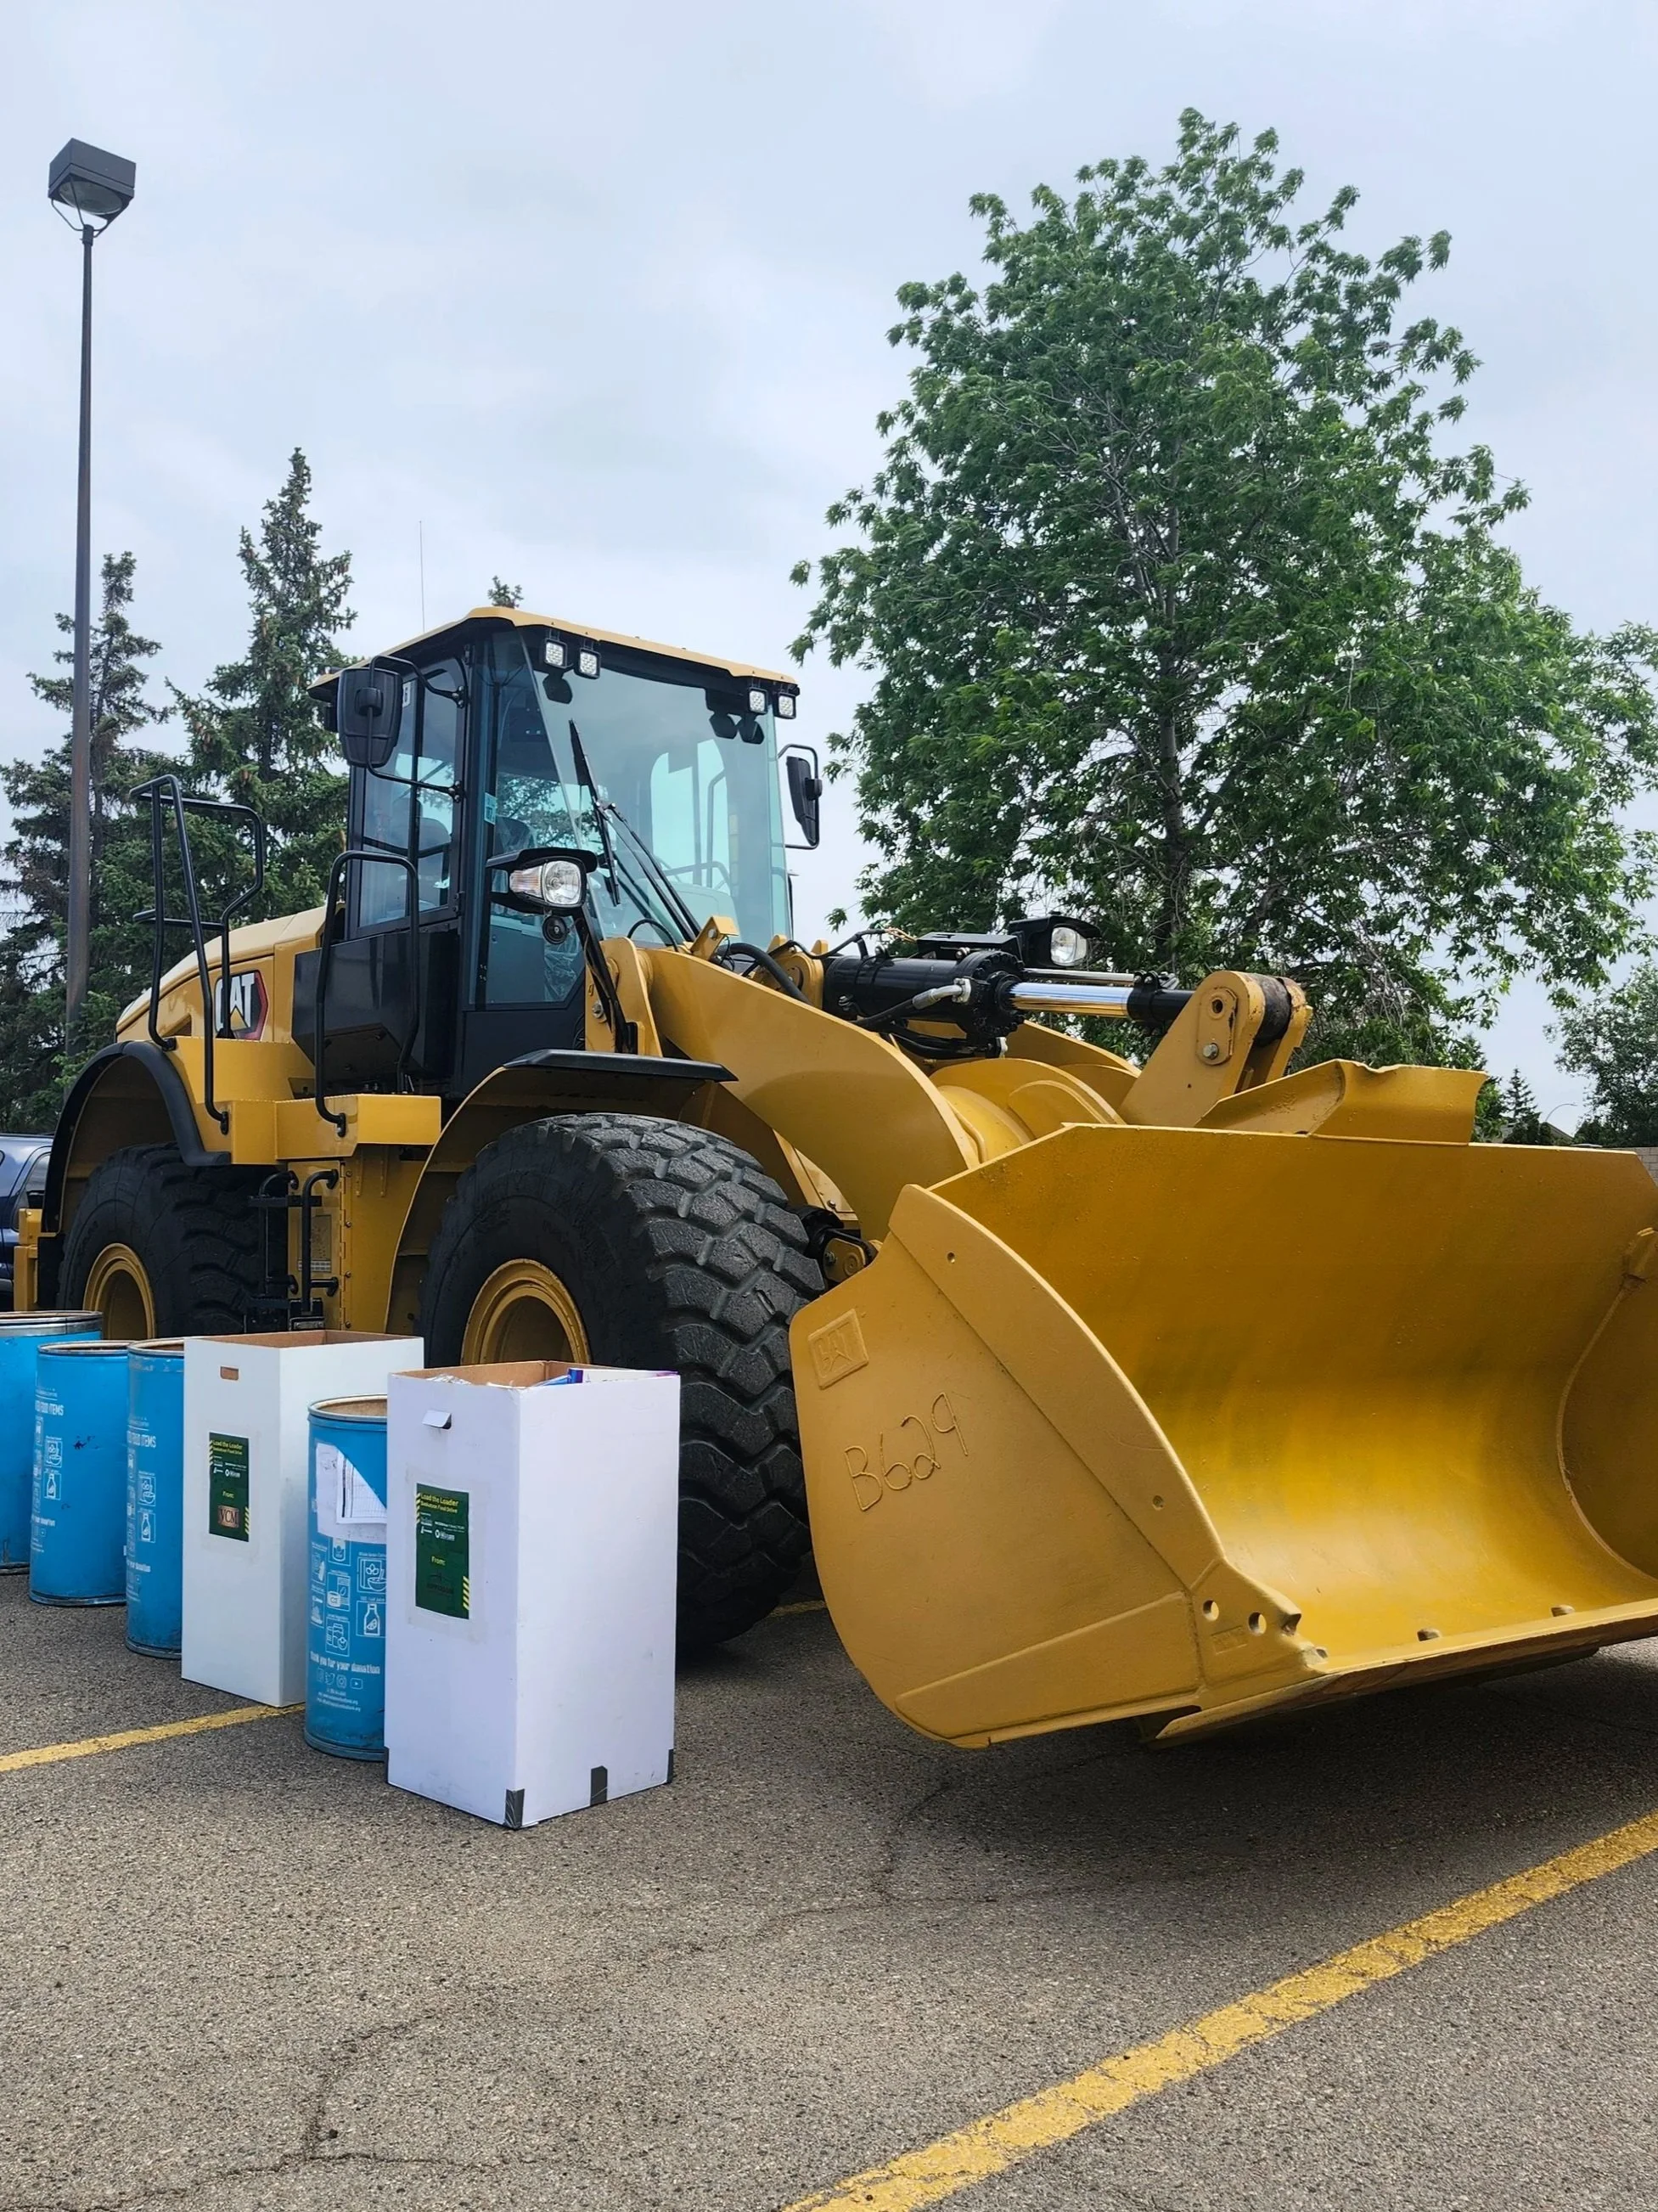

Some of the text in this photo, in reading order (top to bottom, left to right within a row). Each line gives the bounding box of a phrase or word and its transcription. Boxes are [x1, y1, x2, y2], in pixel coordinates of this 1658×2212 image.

[215, 972, 255, 1032] CAT
[49, 1403, 65, 1416] ITEMS
[141, 1434, 156, 1448] ITEMS
[440, 1497, 459, 1506] Loader
[336, 1661, 351, 1671] your
[351, 1663, 380, 1674] donation
